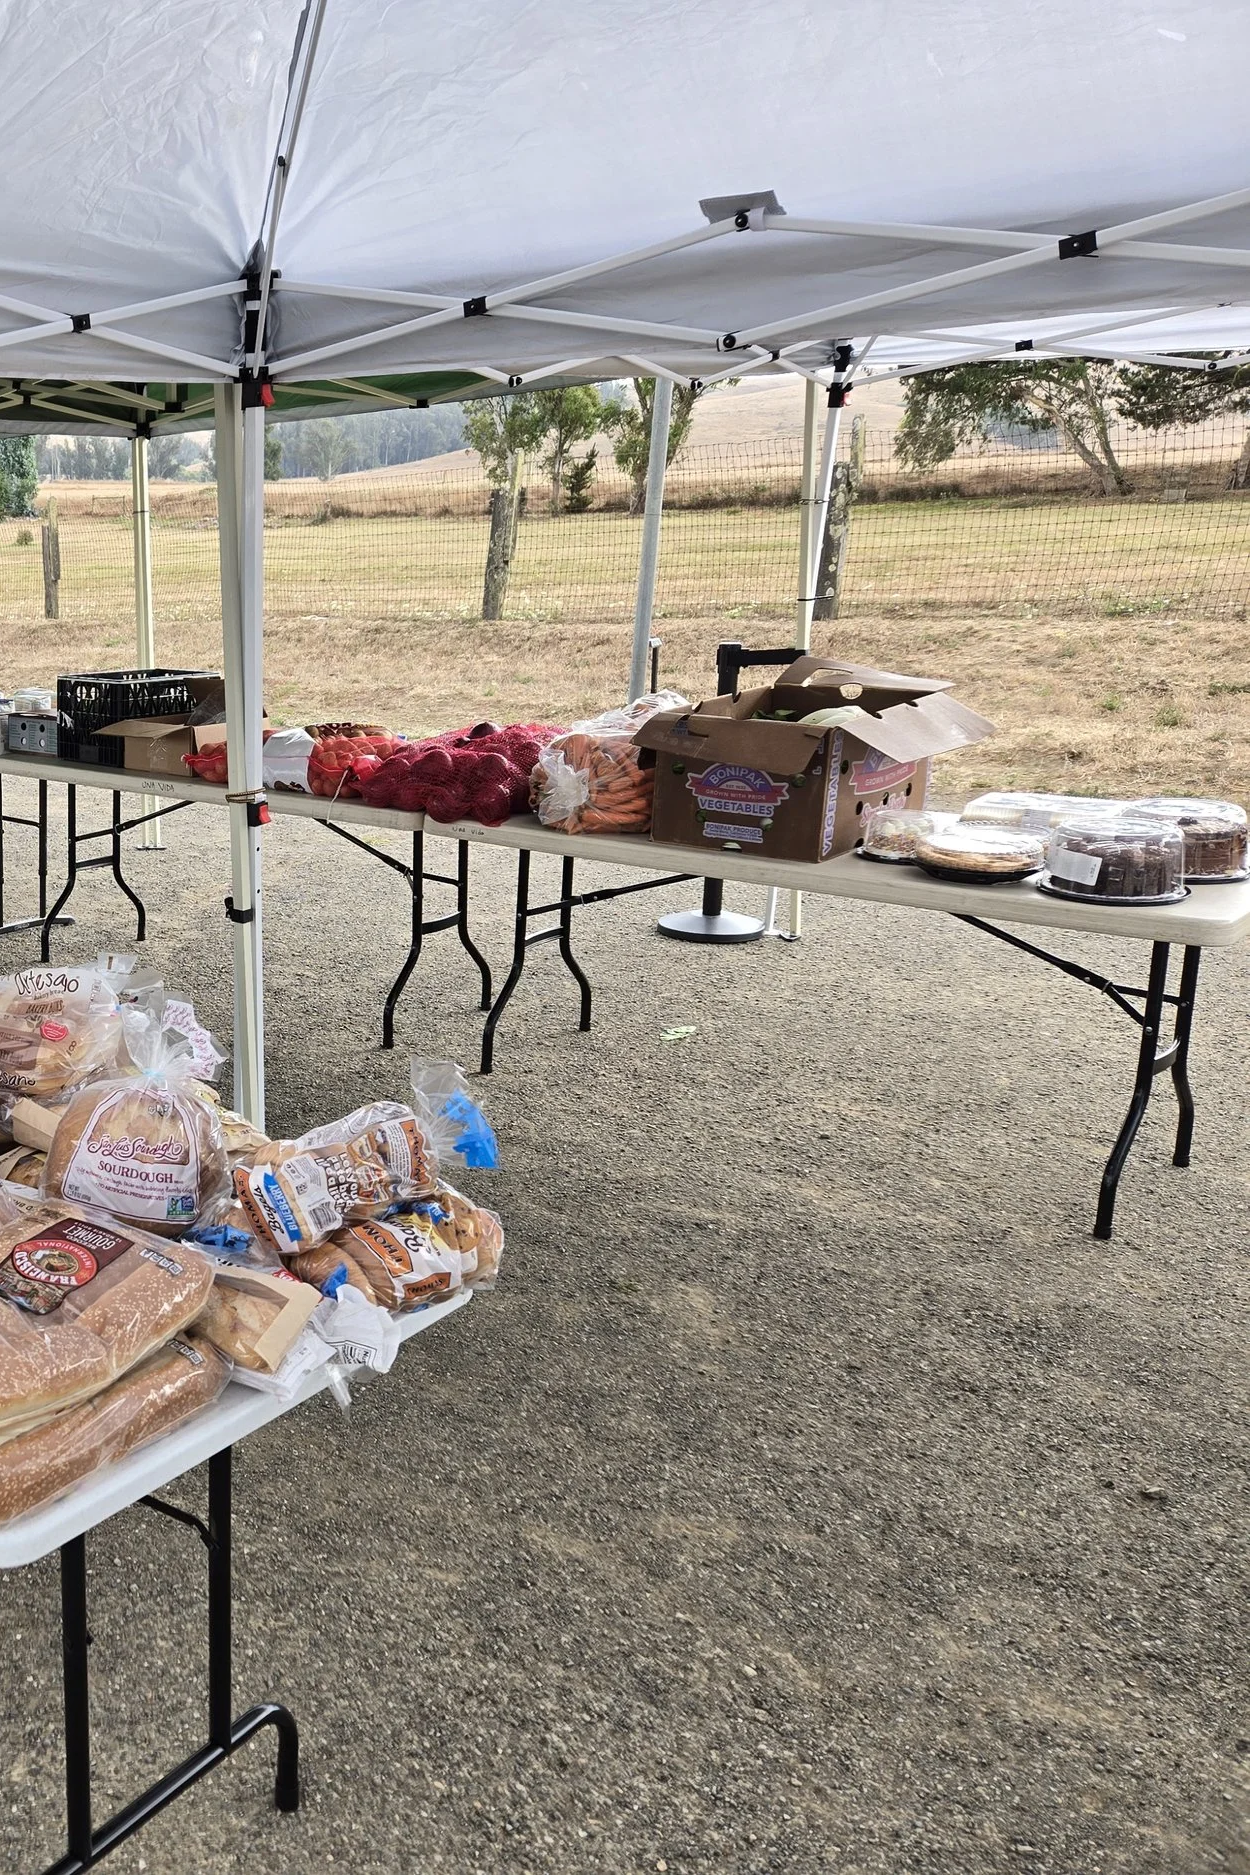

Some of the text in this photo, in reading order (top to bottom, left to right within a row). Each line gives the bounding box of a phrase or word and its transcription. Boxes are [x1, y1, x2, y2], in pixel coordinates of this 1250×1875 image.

[709, 766, 766, 789] BONIPAK
[705, 788, 729, 797] GROWN
[822, 730, 844, 857] VEGETABLES
[699, 799, 773, 815] VEGETABLES
[732, 826, 761, 835] PRODUCE
[101, 1137, 131, 1161] Luis
[119, 1135, 184, 1160] Sourdough
[97, 1160, 174, 1184] SOURDOUGH
[253, 1184, 285, 1235] Bagels
[267, 1184, 299, 1231] BLUEBERRY
[62, 1224, 116, 1250] GOURMET
[362, 1224, 403, 1263] THOM
[14, 1249, 80, 1286] FRANCISCO
[37, 1241, 93, 1269] INTERNATIONAL
